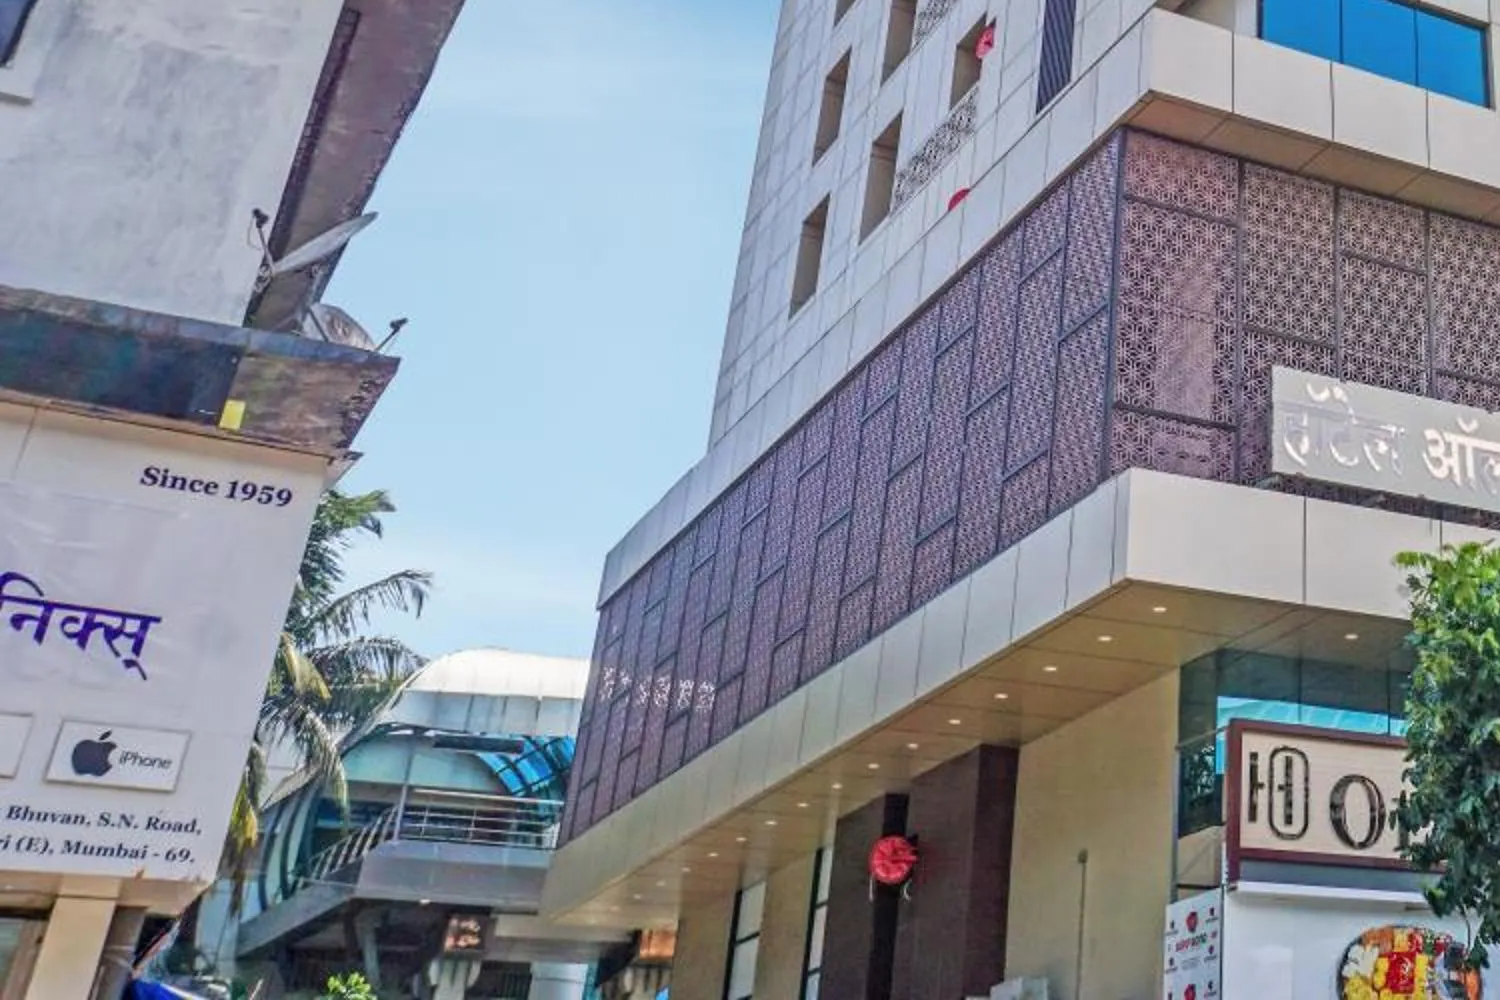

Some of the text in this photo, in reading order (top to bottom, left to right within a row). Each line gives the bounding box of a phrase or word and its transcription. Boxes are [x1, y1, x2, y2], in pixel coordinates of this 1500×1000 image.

[139, 465, 293, 507] Since 1959
[119, 750, 172, 769] iPhone
[6, 804, 202, 836] Bhuvan, S.N. Road,
[15, 836, 54, 856] (E),
[60, 839, 148, 861] Mumbai
[164, 848, 195, 864] 69.
